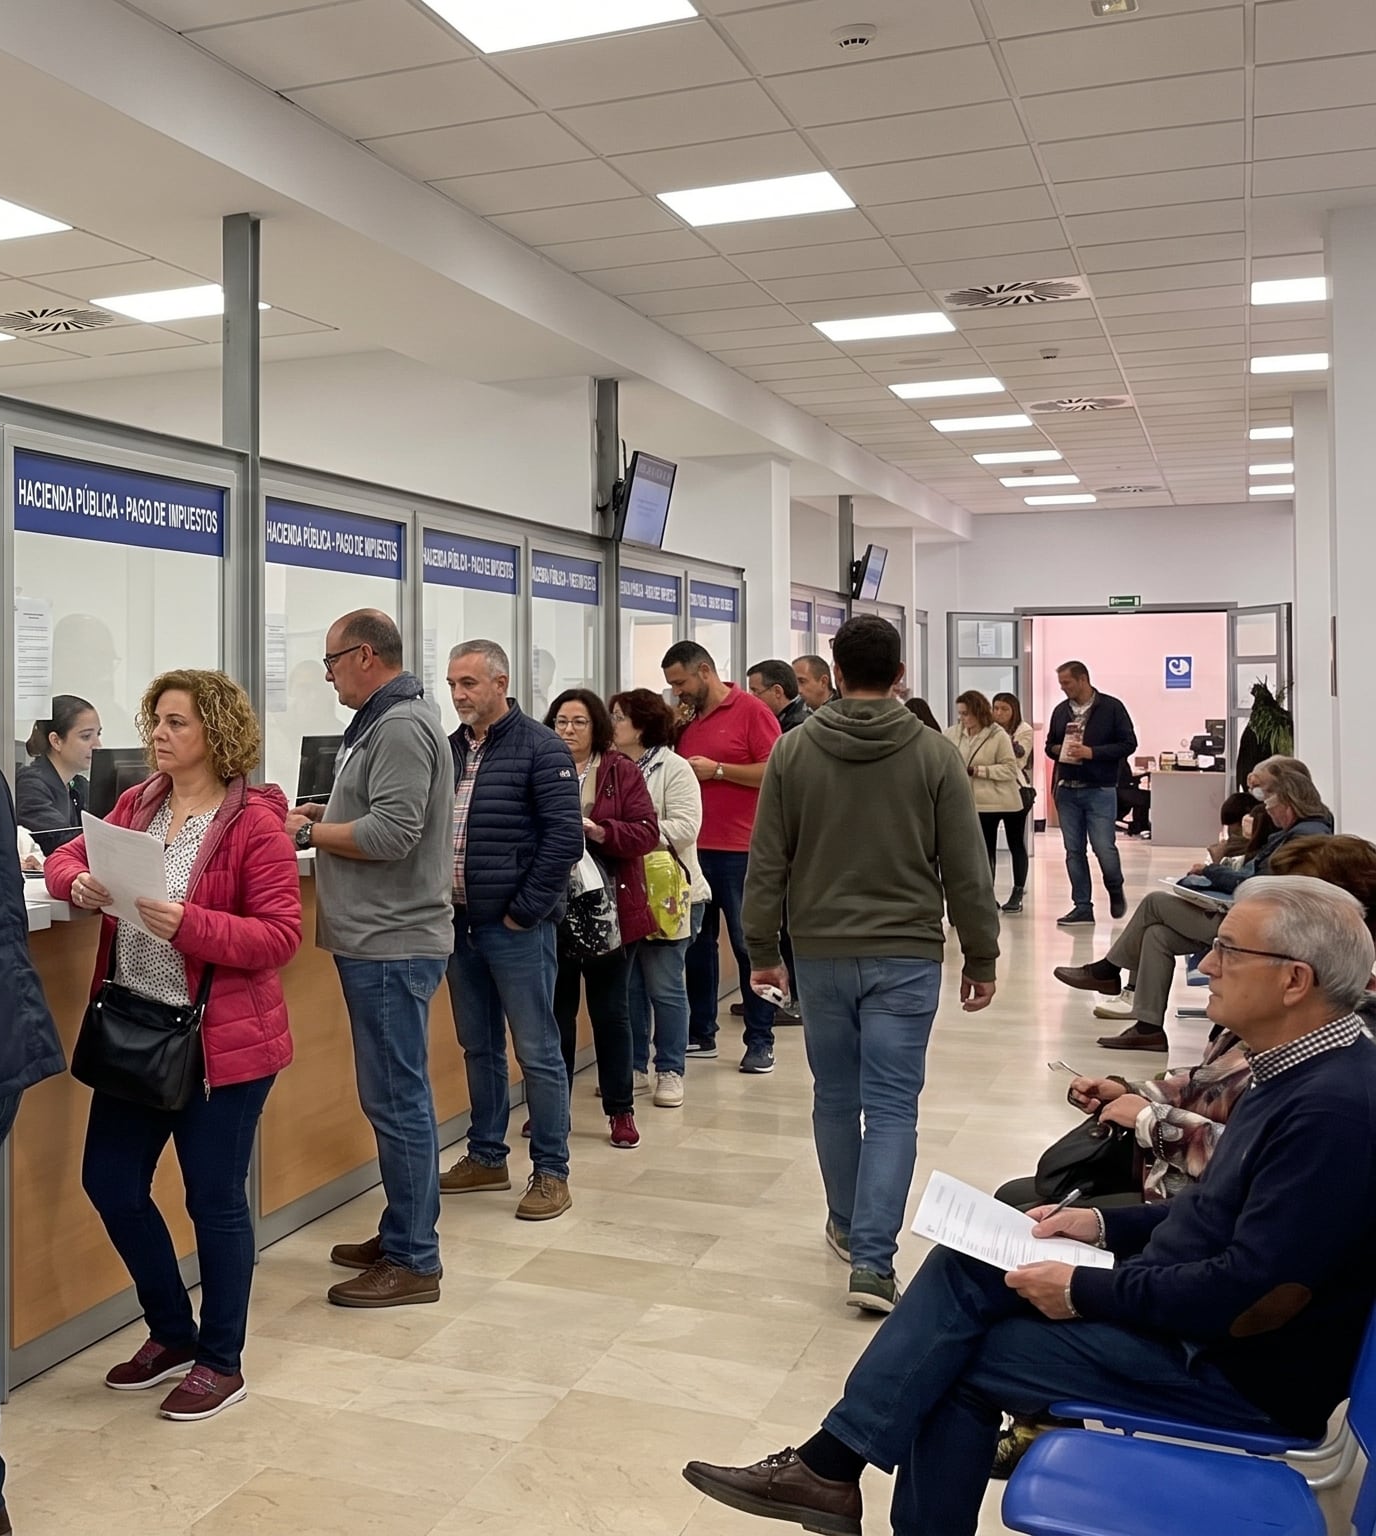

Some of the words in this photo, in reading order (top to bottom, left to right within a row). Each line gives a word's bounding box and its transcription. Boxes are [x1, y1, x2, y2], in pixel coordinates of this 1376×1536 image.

[18, 478, 74, 513] HACIENDA
[75, 483, 119, 520] PÚBLICA
[125, 496, 153, 525] PAGO
[153, 501, 166, 527] DE
[168, 503, 218, 534] IMPUESTOS
[266, 520, 303, 547] HACIENDA
